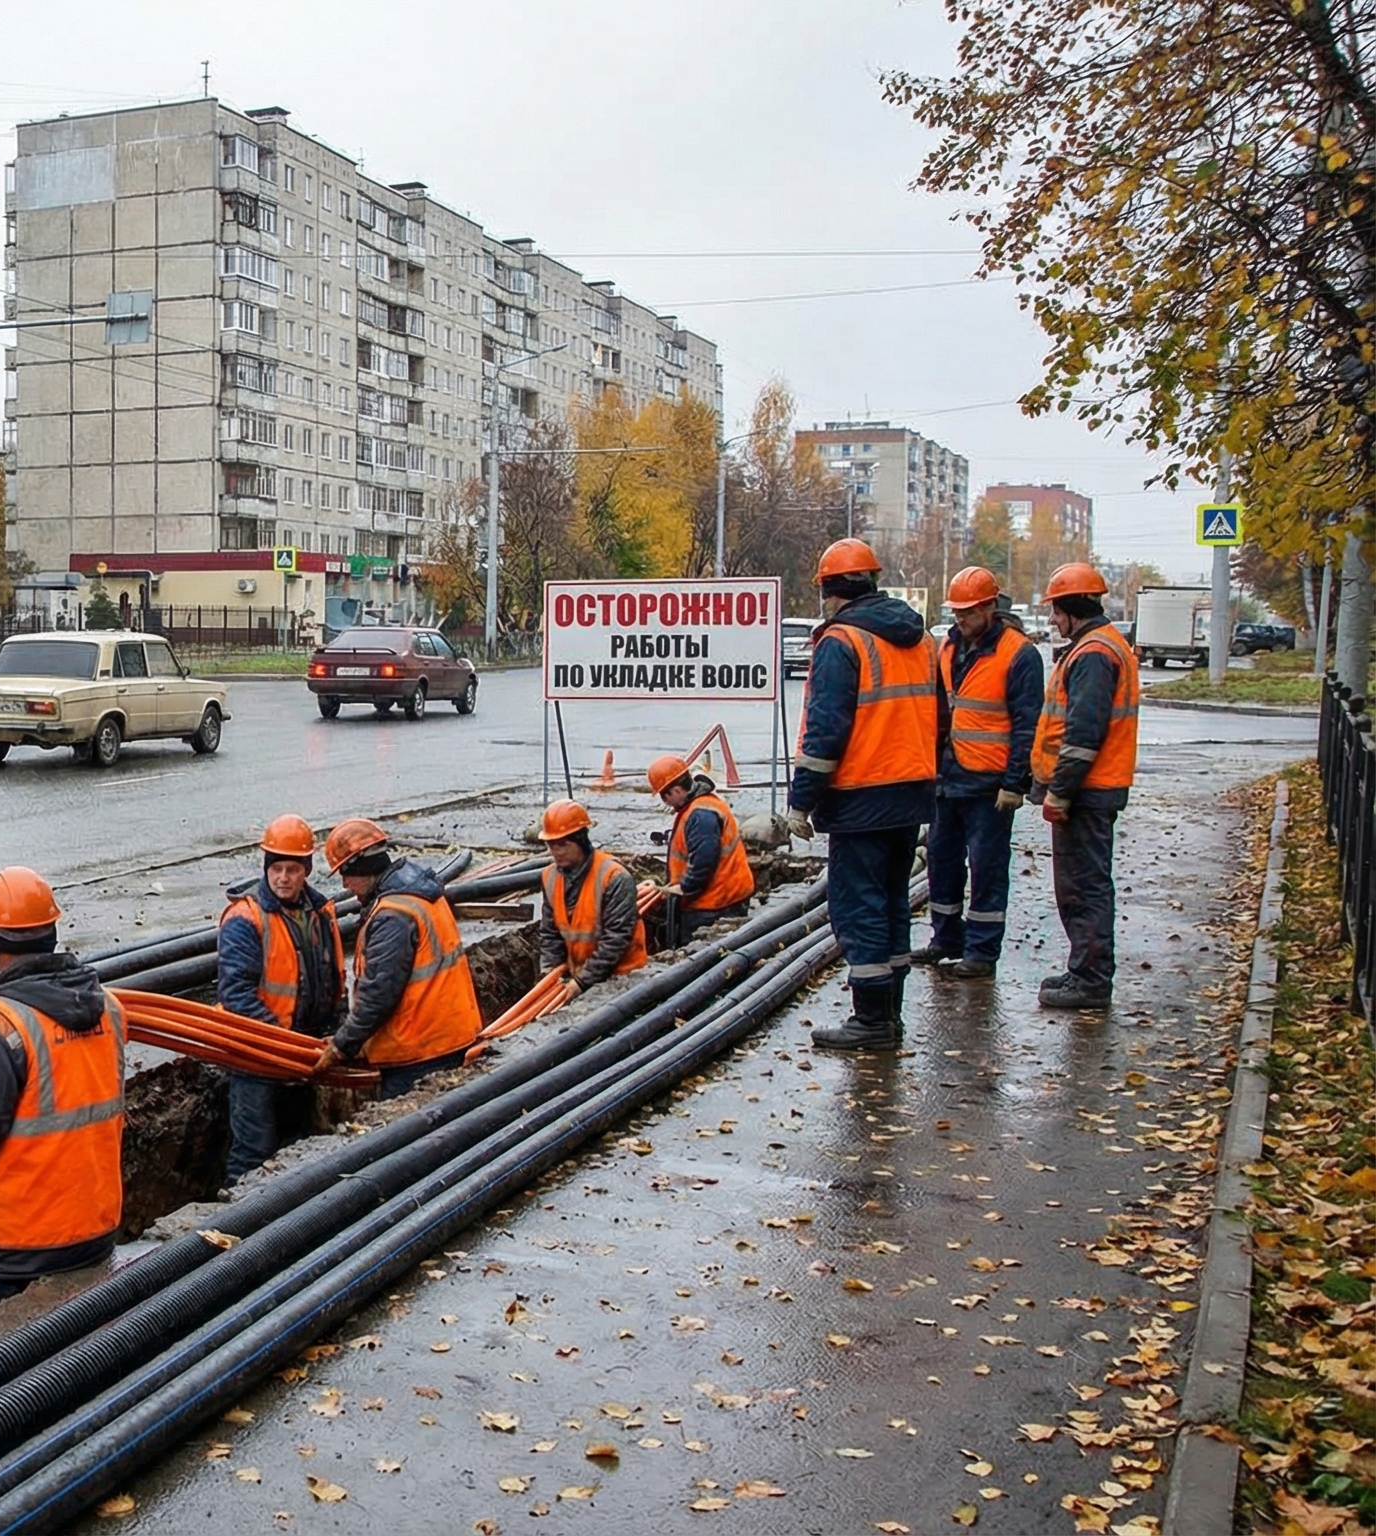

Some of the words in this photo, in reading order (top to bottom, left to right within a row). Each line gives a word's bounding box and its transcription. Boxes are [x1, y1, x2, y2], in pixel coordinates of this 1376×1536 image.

[554, 592, 769, 627] ОСТОРОЖНО!
[611, 634, 709, 658] РАБОТЫ
[554, 664, 584, 688] ПО
[590, 664, 695, 692] УКЛАДКЕ
[701, 664, 767, 689] ВОЛС
